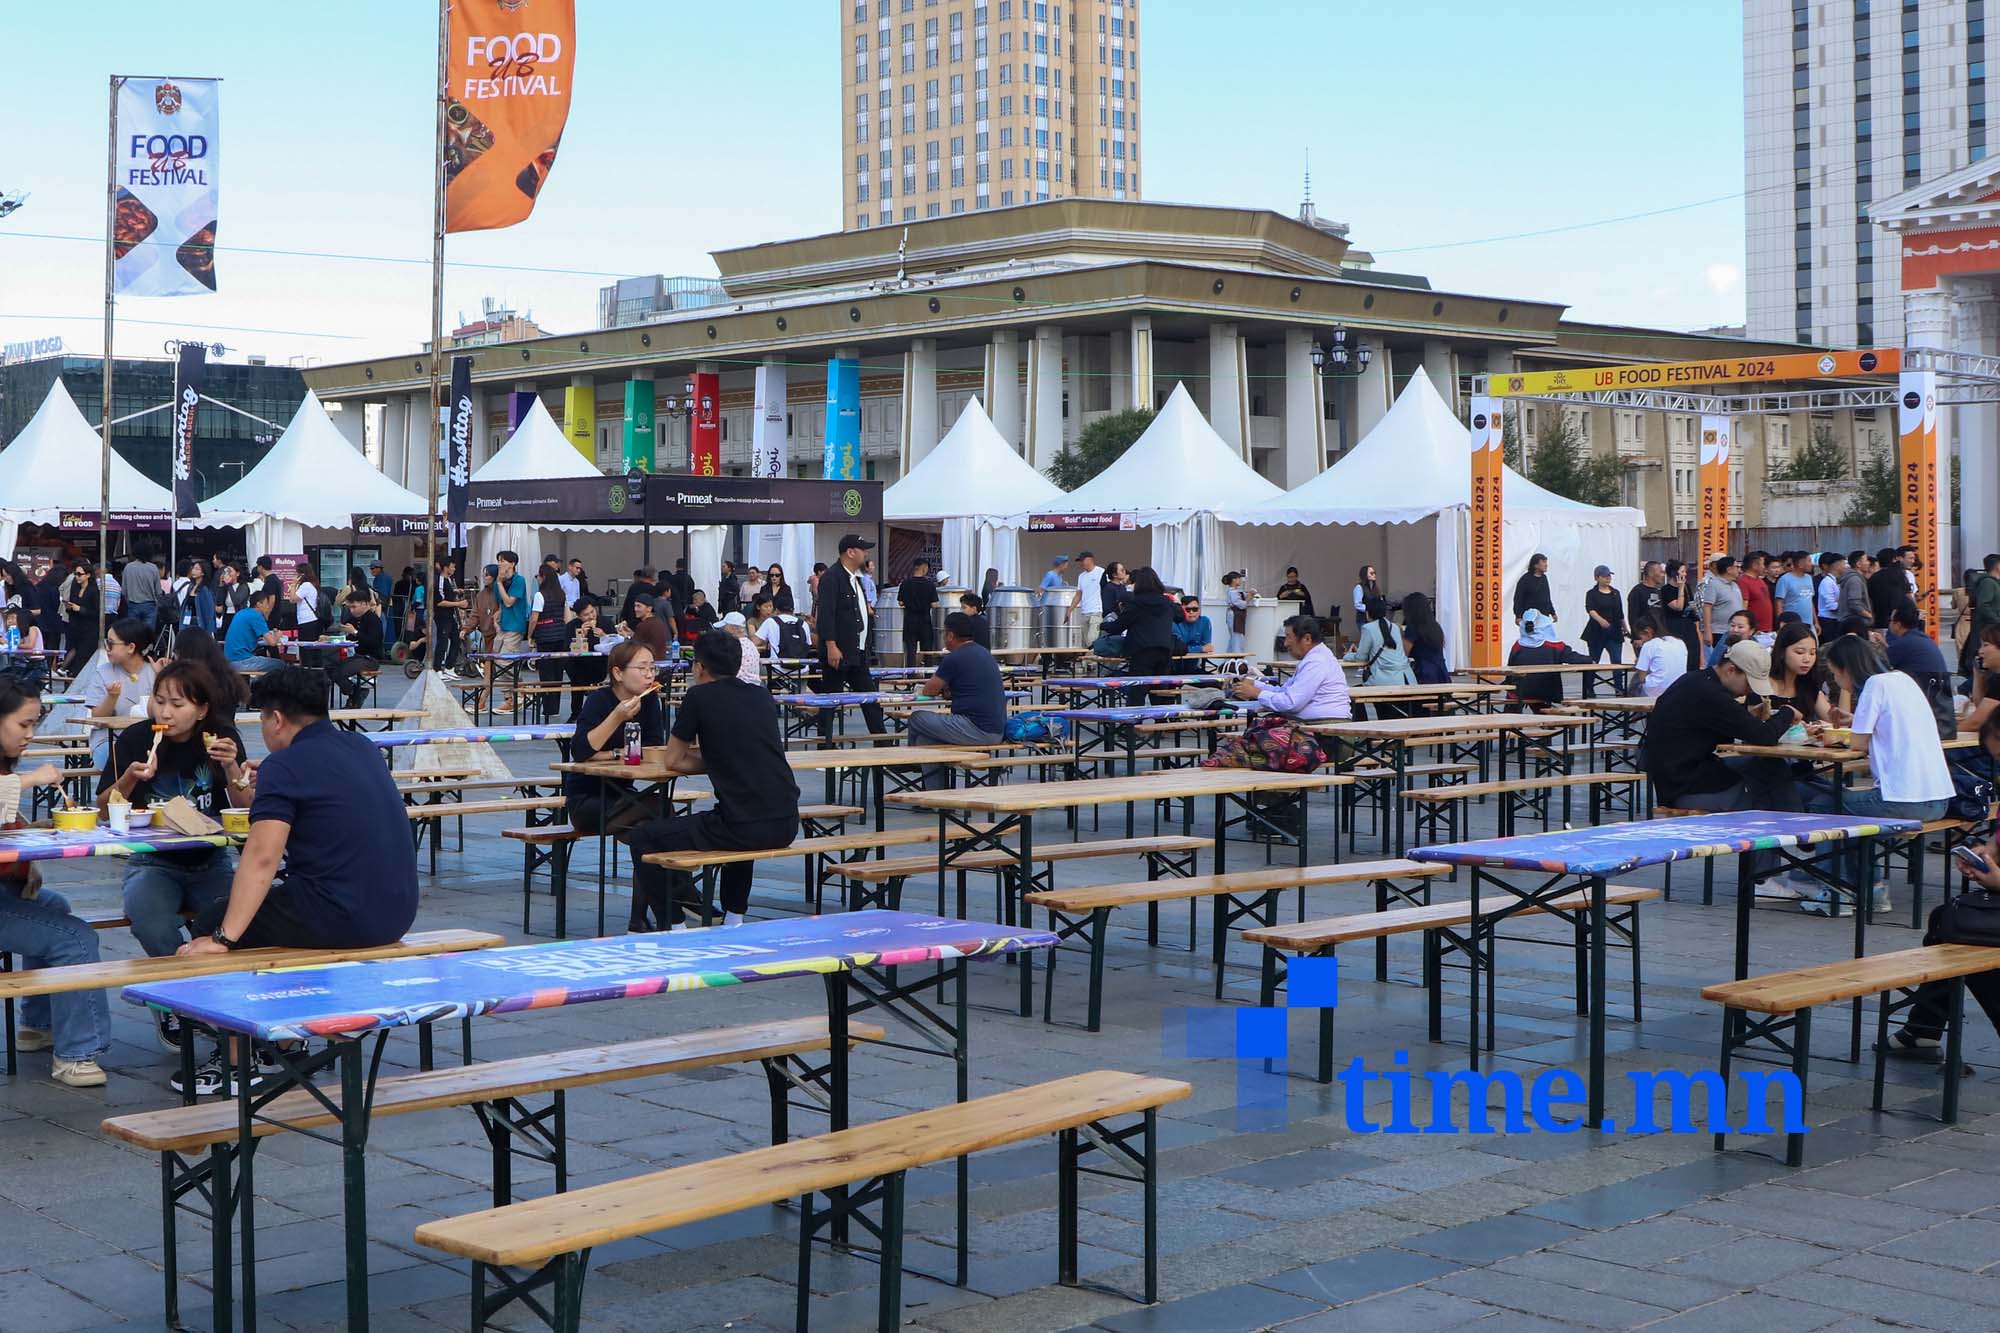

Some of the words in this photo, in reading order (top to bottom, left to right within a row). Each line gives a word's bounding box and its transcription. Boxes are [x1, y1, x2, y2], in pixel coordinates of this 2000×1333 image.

[467, 32, 561, 67] FOOD
[464, 75, 561, 99] FESTIVAL
[130, 134, 208, 159] FOOD
[128, 168, 208, 186] FESTIVAL
[1595, 372, 1614, 386] UB
[1619, 368, 1661, 384] FOOD
[1667, 364, 1731, 382] FESTIVAL
[1737, 361, 1775, 377] 2024
[1475, 476, 1484, 512] 2024
[1907, 462, 1919, 503] 2024
[476, 497, 502, 509] Primeat
[677, 492, 712, 505] Primeat
[1704, 487, 1713, 519] 2024
[110, 513, 132, 521] Hashtag
[402, 519, 443, 531] Primat
[1475, 516, 1484, 577] FESTIVAL
[1928, 507, 1936, 577] FESTIVAL
[1475, 582, 1484, 620] FOOD
[1475, 624, 1484, 642] UB
[1492, 624, 1499, 642] UB
